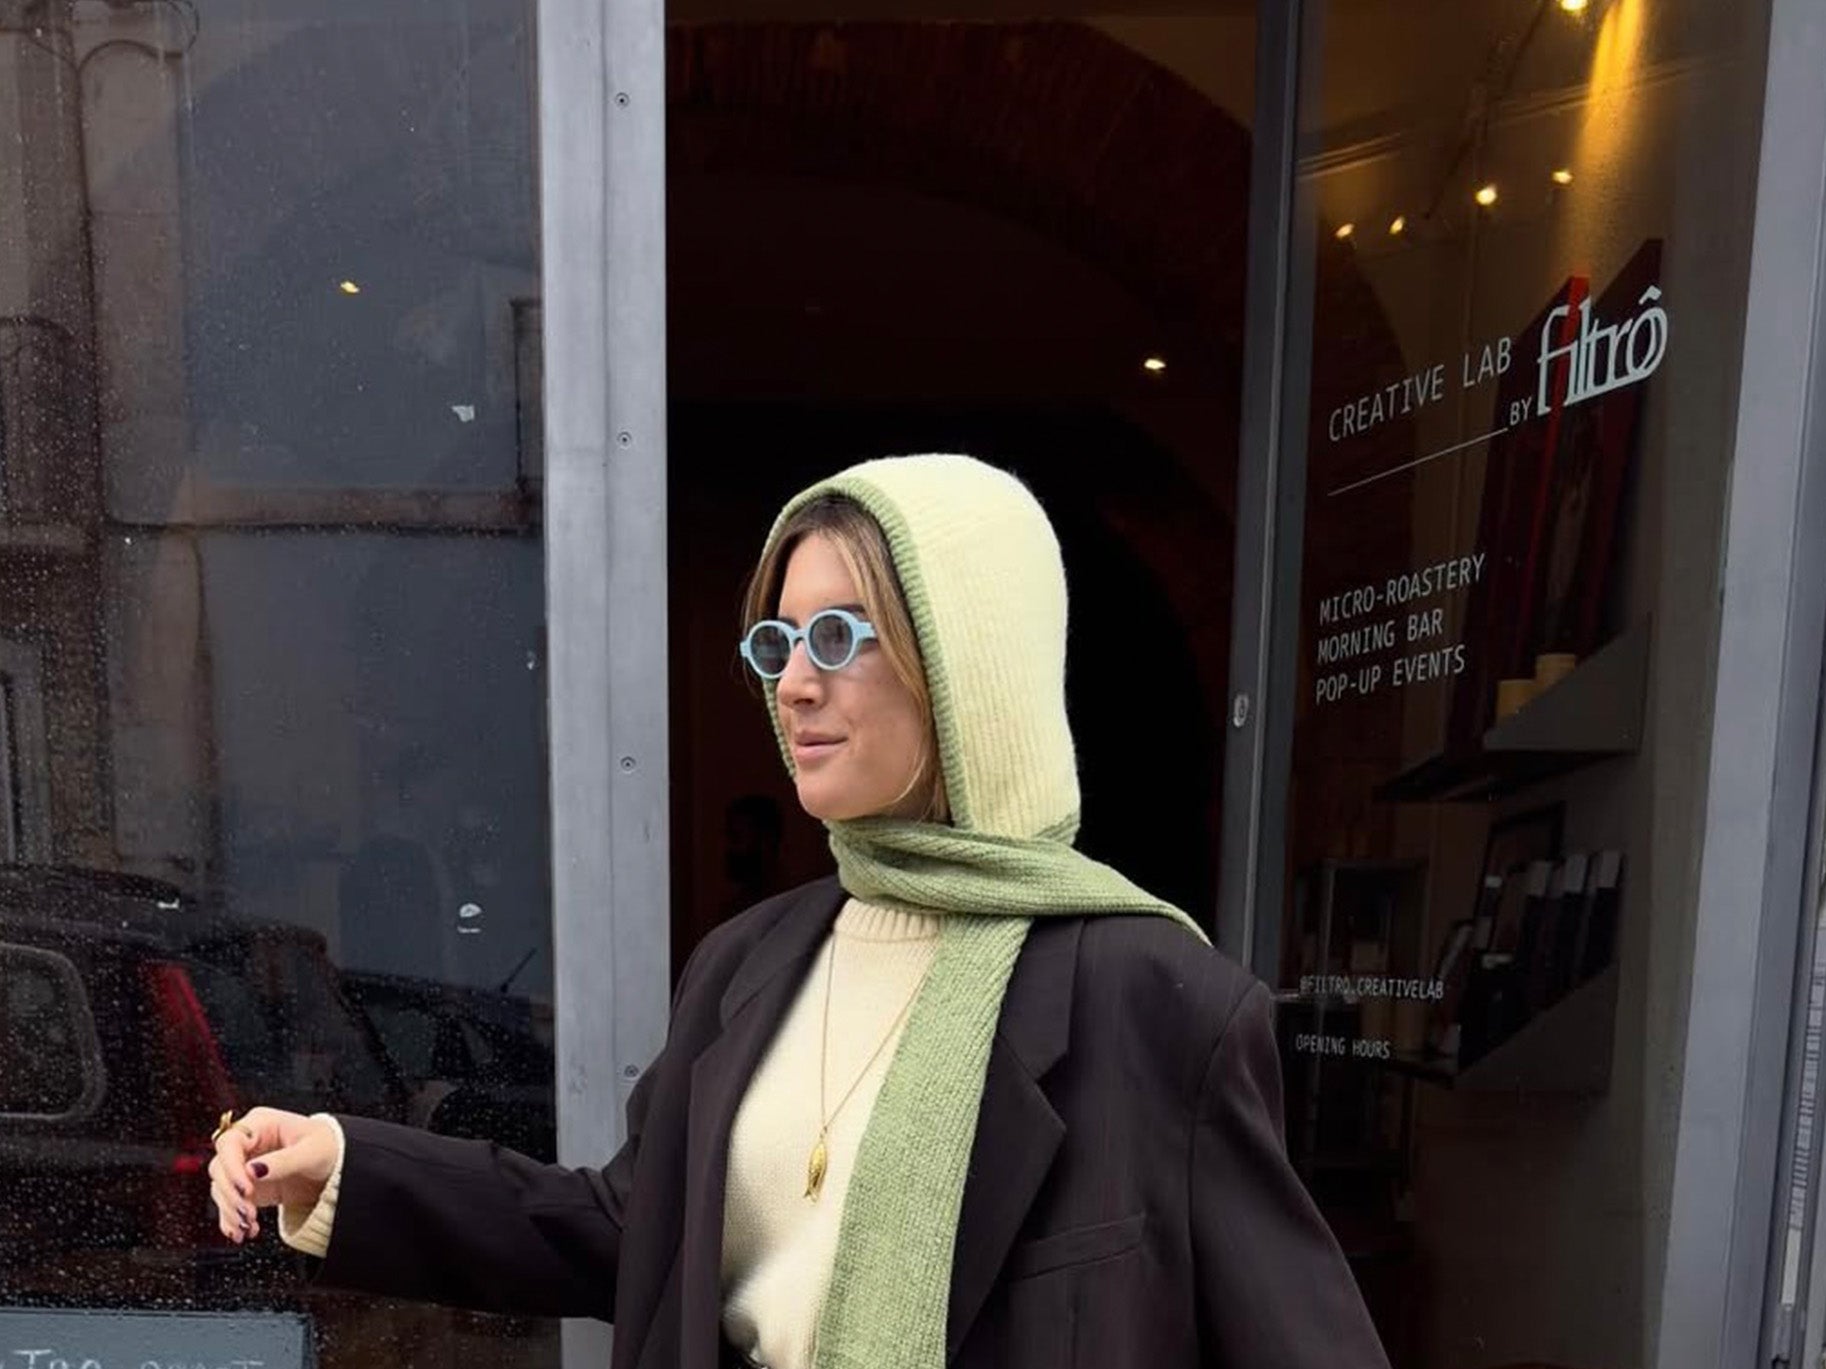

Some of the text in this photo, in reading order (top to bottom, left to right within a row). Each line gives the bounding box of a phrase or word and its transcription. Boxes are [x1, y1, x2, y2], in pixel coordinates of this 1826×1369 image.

[1329, 337, 1512, 442] CREATIVE LAB
[1510, 397, 1532, 425] BY
[1319, 553, 1486, 626] MICRO-ROASTERY
[1317, 608, 1443, 666] MORNING BAR
[1316, 644, 1466, 705] POP-UP EVENTS
[1296, 1034, 1390, 1060] OPENING HOURS
